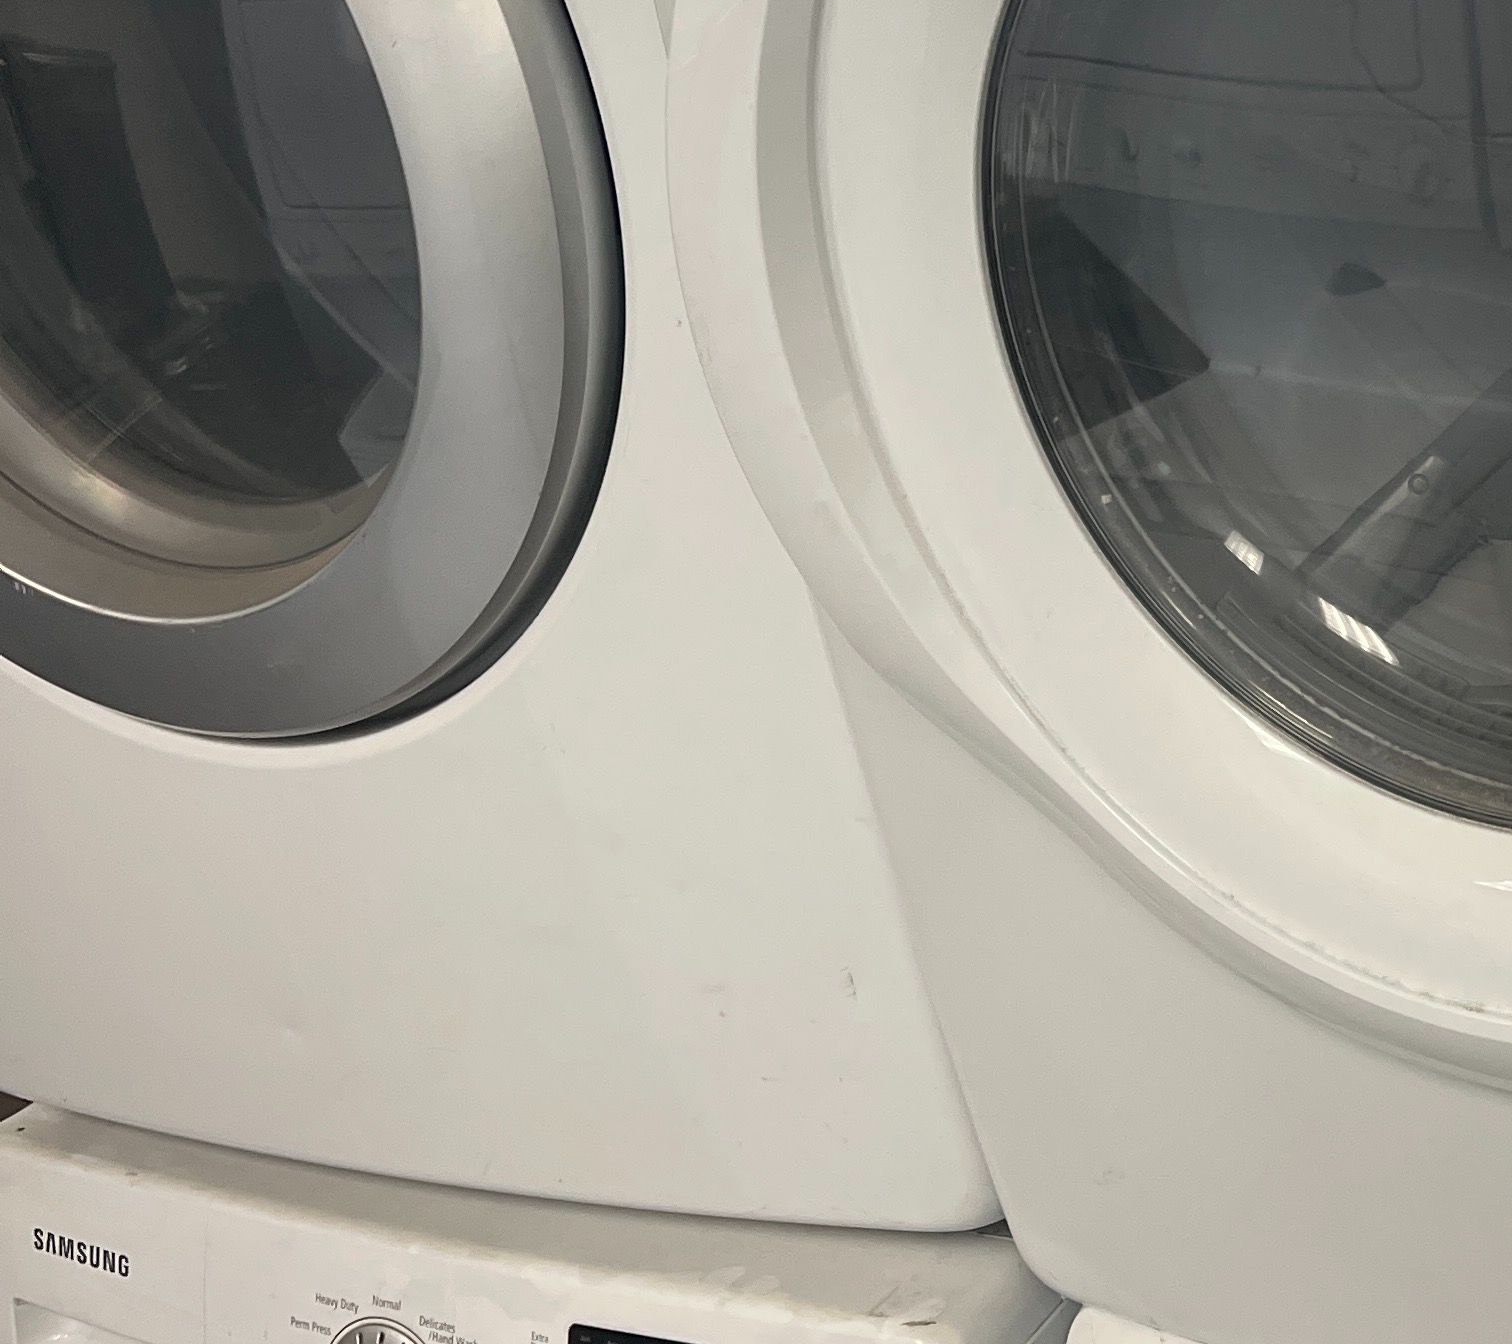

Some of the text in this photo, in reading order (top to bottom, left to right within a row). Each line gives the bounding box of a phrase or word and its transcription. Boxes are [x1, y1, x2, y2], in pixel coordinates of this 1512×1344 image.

[33, 1228, 130, 1277] SAMSUNG
[315, 1293, 359, 1314] Heavy Duty
[373, 1295, 401, 1310] Normal
[290, 1316, 332, 1336] Perm Press
[419, 1315, 456, 1334] Delicates
